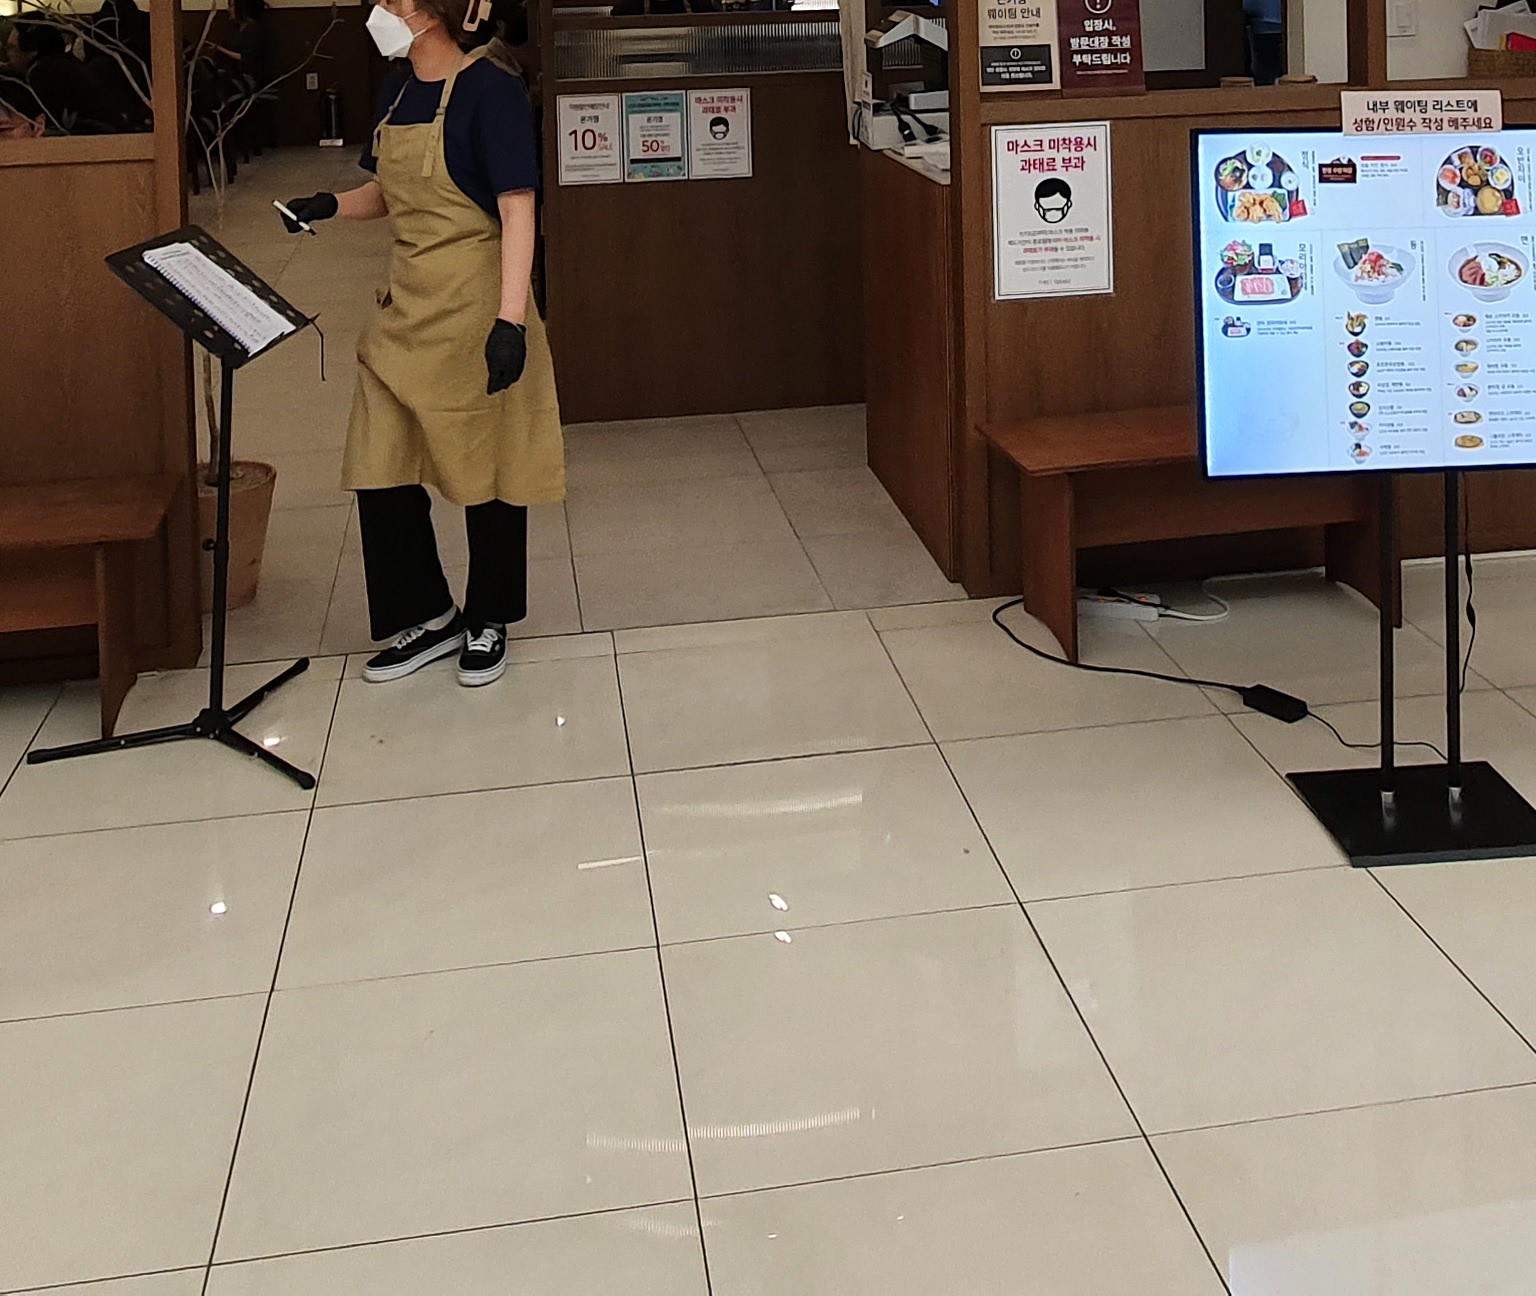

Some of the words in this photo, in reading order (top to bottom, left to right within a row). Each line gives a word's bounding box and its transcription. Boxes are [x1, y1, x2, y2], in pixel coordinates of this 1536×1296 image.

[987, 8, 1017, 19] 웨이팅
[1020, 7, 1041, 19] 안내
[1111, 35, 1131, 47] 작성
[1367, 100, 1389, 113] 내부
[1394, 100, 1428, 113] 웨이팅
[1432, 99, 1478, 112] 리스트에
[1352, 117, 1417, 132] 성함/인원수
[1421, 117, 1444, 131] 작성
[1448, 116, 1493, 130] 해주세요
[1007, 139, 1044, 154] 마스크
[1048, 136, 1097, 153] 미착용시
[1020, 157, 1058, 173] 과태료
[1061, 156, 1085, 172] 부과
